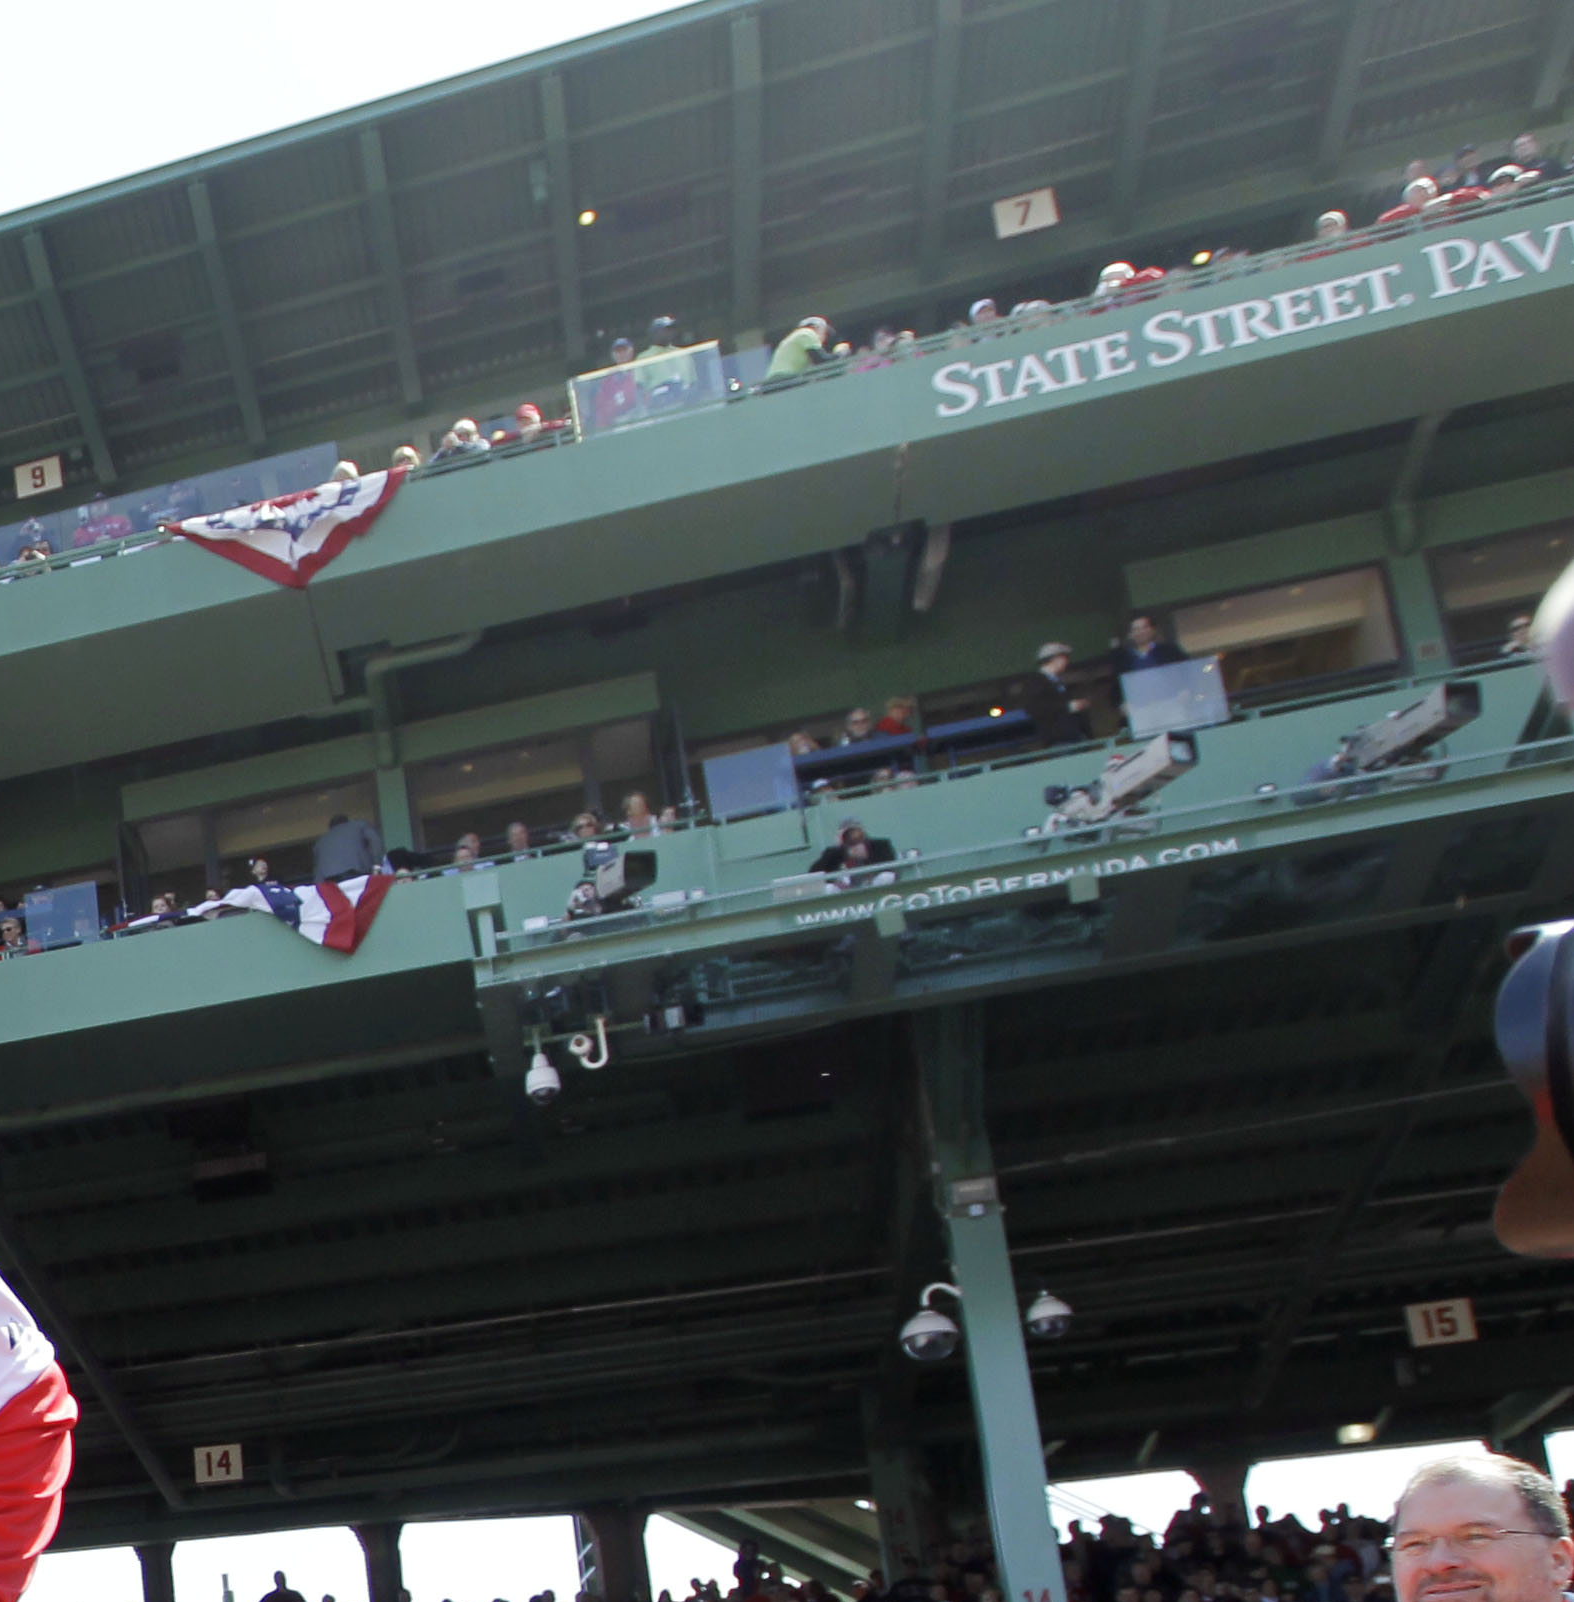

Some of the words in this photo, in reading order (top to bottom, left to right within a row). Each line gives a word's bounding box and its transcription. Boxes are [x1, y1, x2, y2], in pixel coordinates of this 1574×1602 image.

[1014, 199, 1032, 227] 7
[932, 330, 1136, 416] STATE
[31, 465, 46, 488] 9
[1419, 1305, 1458, 1340] 15
[206, 1450, 233, 1477] 14
